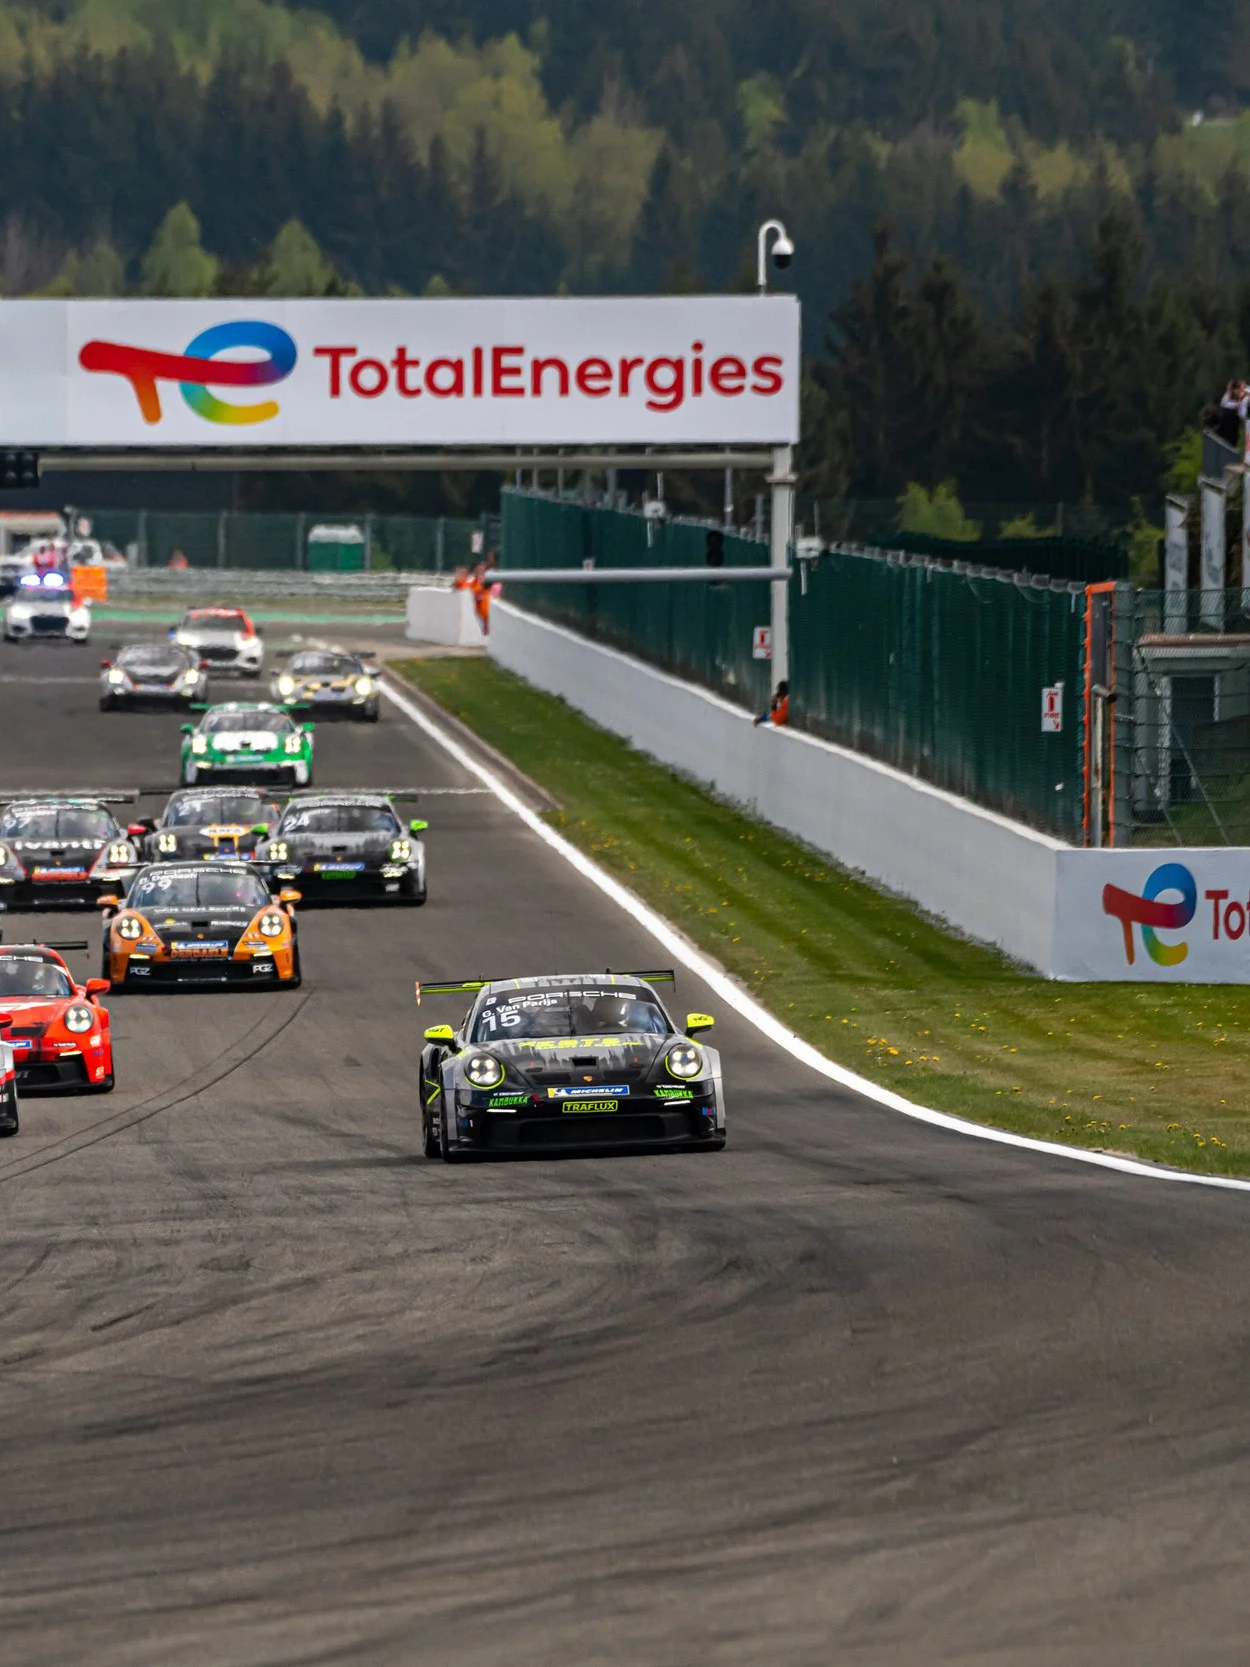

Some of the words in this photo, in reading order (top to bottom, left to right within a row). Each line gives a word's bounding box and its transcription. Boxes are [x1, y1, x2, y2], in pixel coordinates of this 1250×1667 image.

[313, 341, 785, 414] TotalEnergies
[1205, 889, 1250, 941] To
[508, 990, 637, 1004] PORSCHE
[482, 1010, 495, 1019] G.
[496, 1004, 520, 1013] Van
[522, 998, 558, 1009] Parijs
[482, 1010, 522, 1032] 15
[565, 1101, 616, 1112] TRAFLUX
